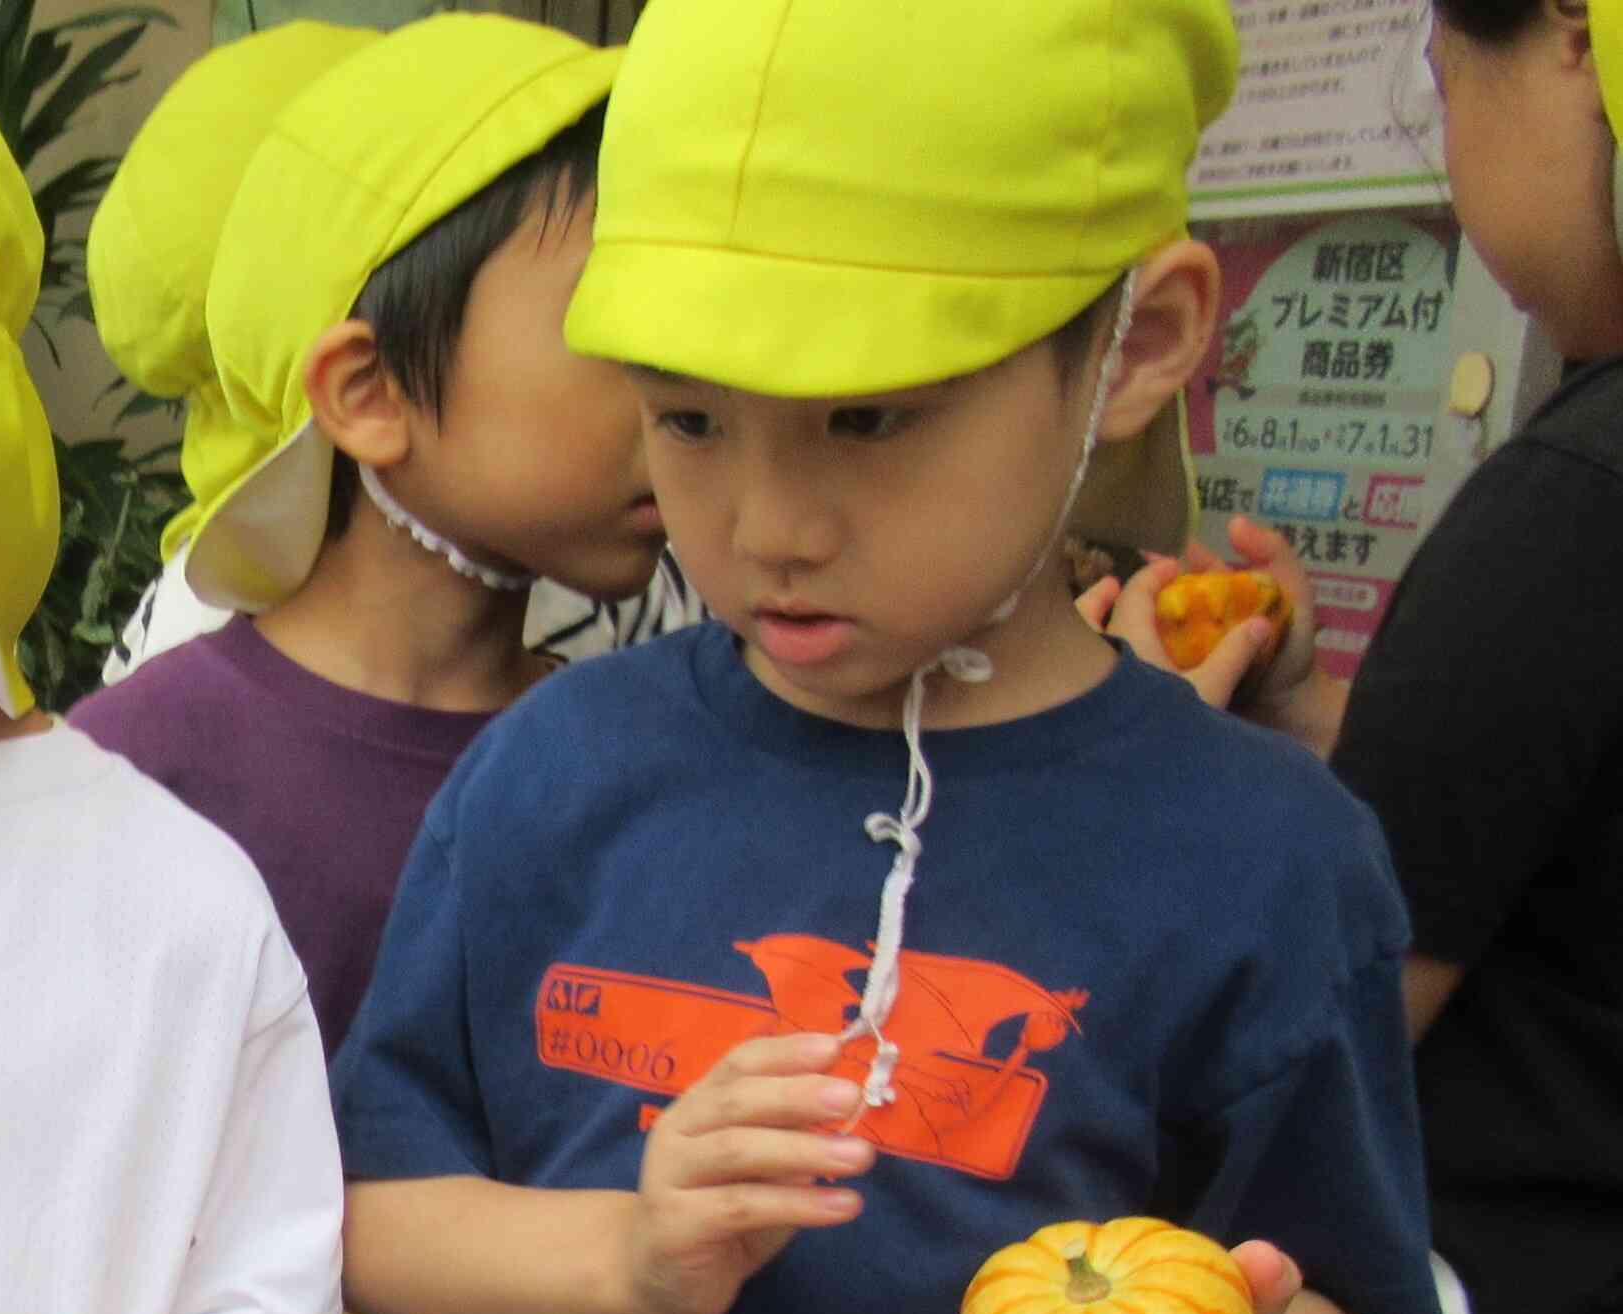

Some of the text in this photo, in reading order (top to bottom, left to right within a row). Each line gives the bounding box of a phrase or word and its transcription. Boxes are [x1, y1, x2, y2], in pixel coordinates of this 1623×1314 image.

[1312, 240, 1409, 283] 新宿区
[1271, 290, 1445, 333] プレミアム付
[1300, 340, 1395, 379] 商品券
[551, 1026, 675, 1082] #0006
